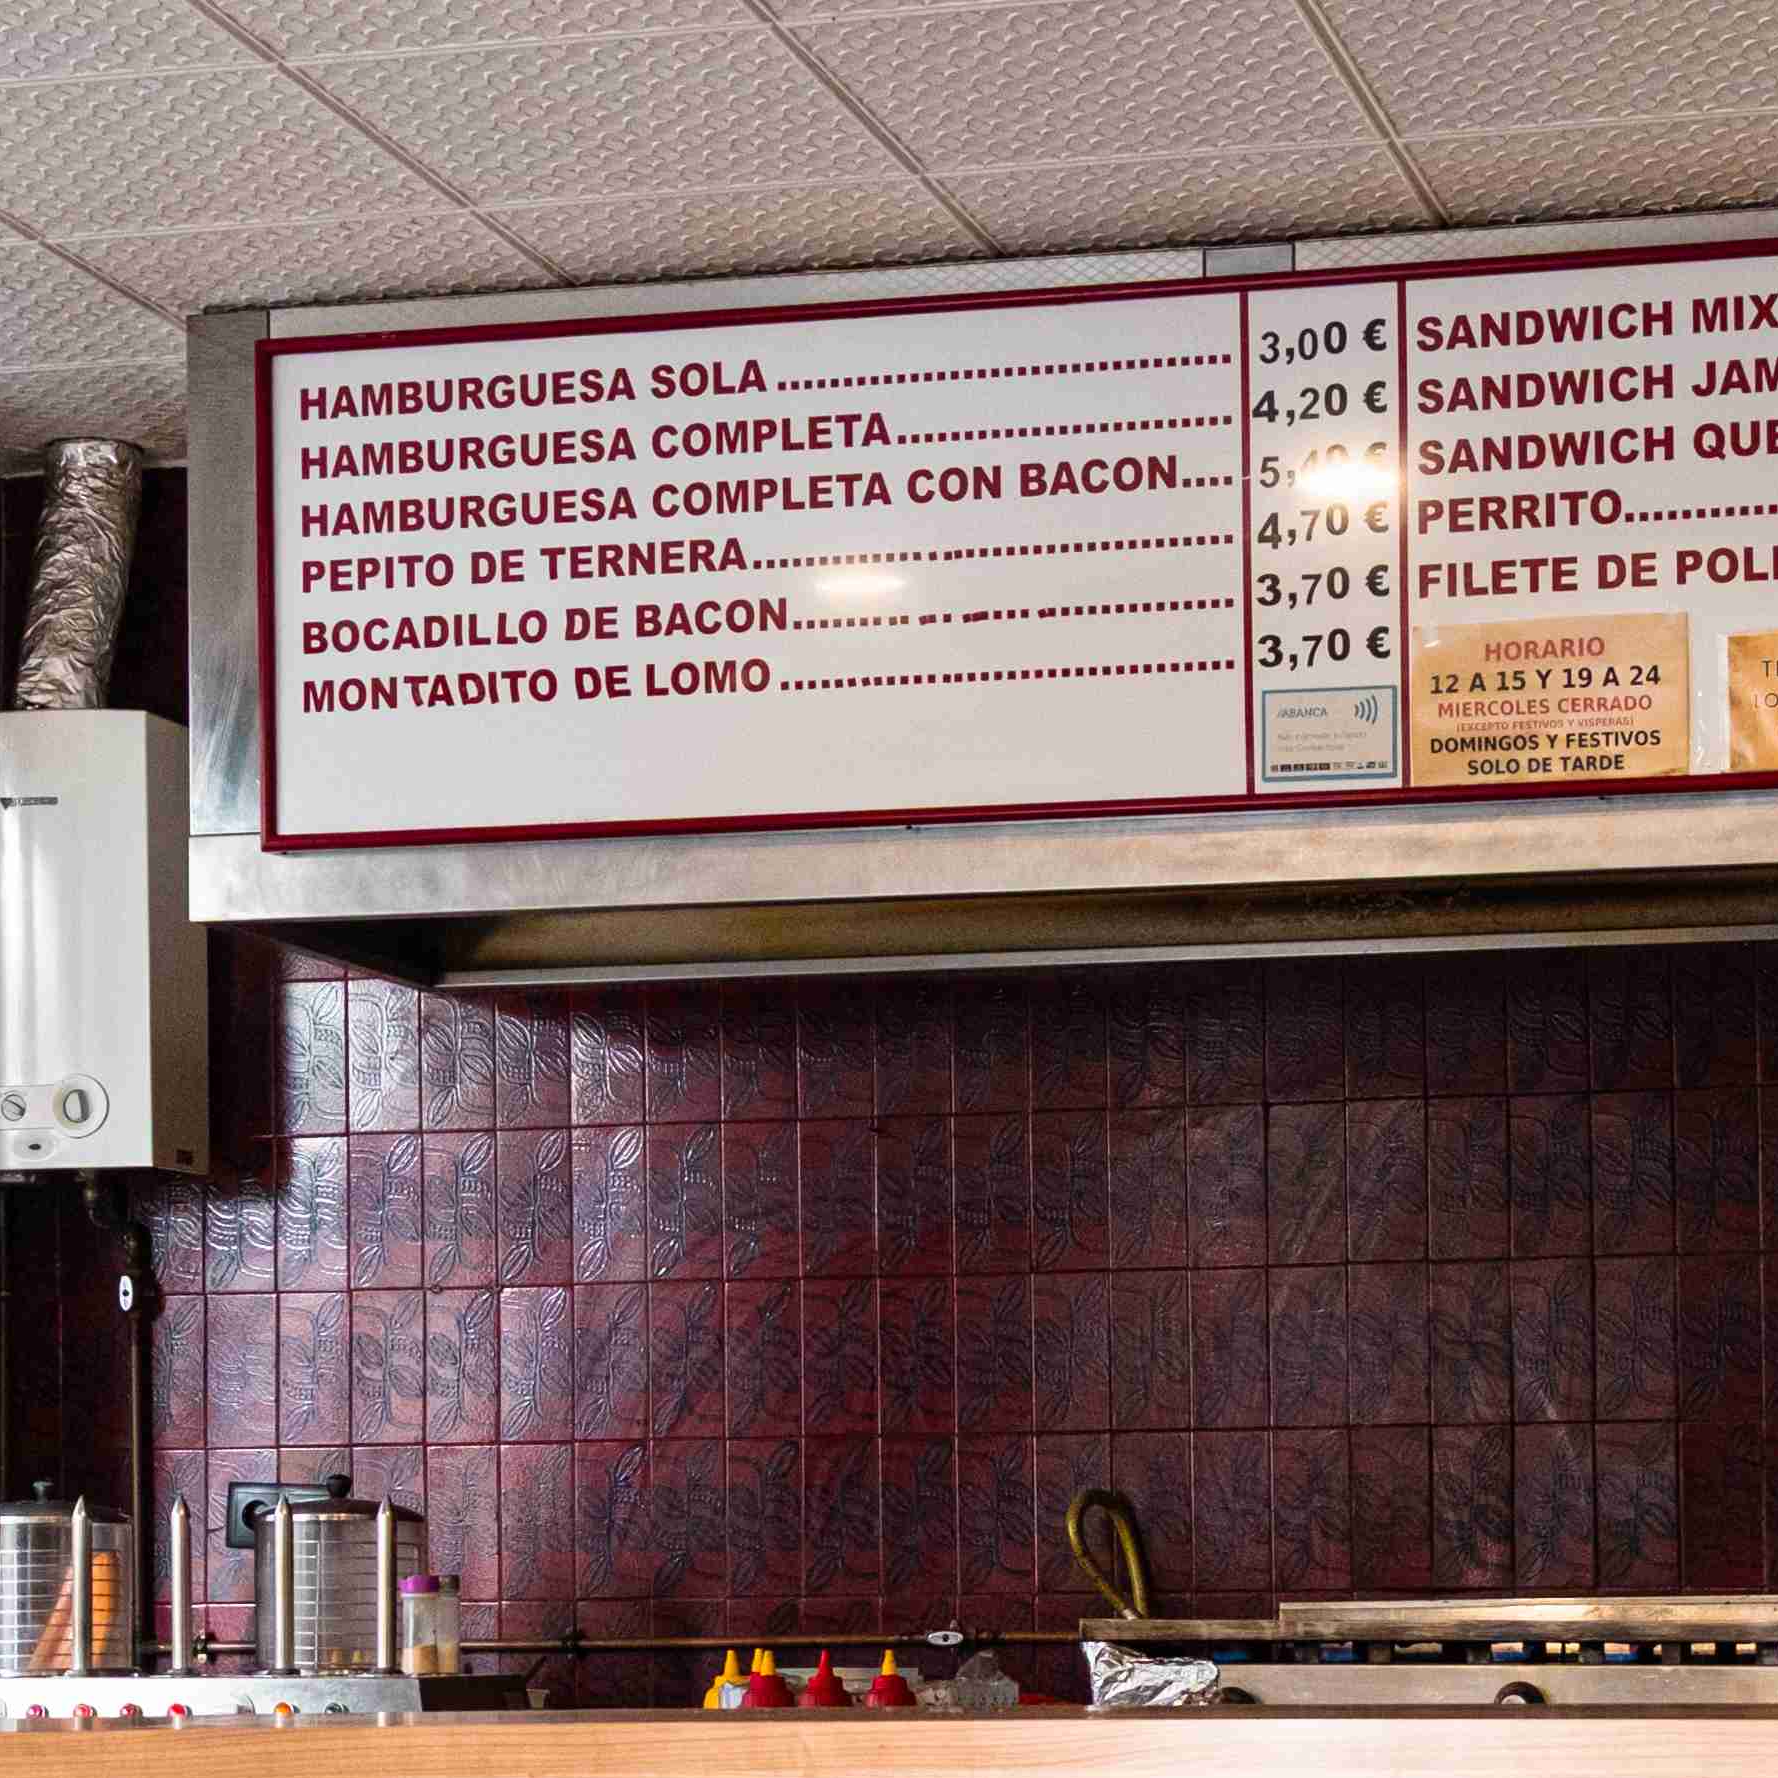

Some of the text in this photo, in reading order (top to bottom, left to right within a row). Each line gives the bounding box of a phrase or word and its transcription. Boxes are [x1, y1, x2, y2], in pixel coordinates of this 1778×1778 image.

[1416, 300, 1673, 353] SANDWICH
[299, 319, 1387, 421] HAMBURGUESA SOLA 3,00 €
[1417, 363, 1674, 415] SANDWICH
[301, 381, 1387, 480] HAMBURGUESA COMPLETA 4,20 €
[1419, 425, 1675, 476] SANDWICH
[301, 486, 638, 538] HAMBURGUESA
[652, 471, 892, 518] COMPLETA
[907, 465, 1002, 504] CON
[1019, 454, 1177, 498] BACON
[1418, 488, 1622, 535] PERRITO
[302, 502, 1388, 594] PEPITO DE TERNERA 4,70 €
[1418, 556, 1578, 599] FILETE
[1597, 551, 1658, 590] DE
[302, 565, 1389, 655] BOCADILLO DE BACON 3,70 €
[303, 627, 1390, 714] MONTADITO DE LOMO 3,70 €
[1485, 636, 1605, 662] HORARIO
[1430, 665, 1661, 694] 12 A 15 Y 19 A 24
[1438, 695, 1652, 718] MIERCOLES CERRADO
[1430, 730, 1661, 753] DOMINGOS Y FESTIVOS
[1468, 754, 1624, 775] SOLO DE TARDE
